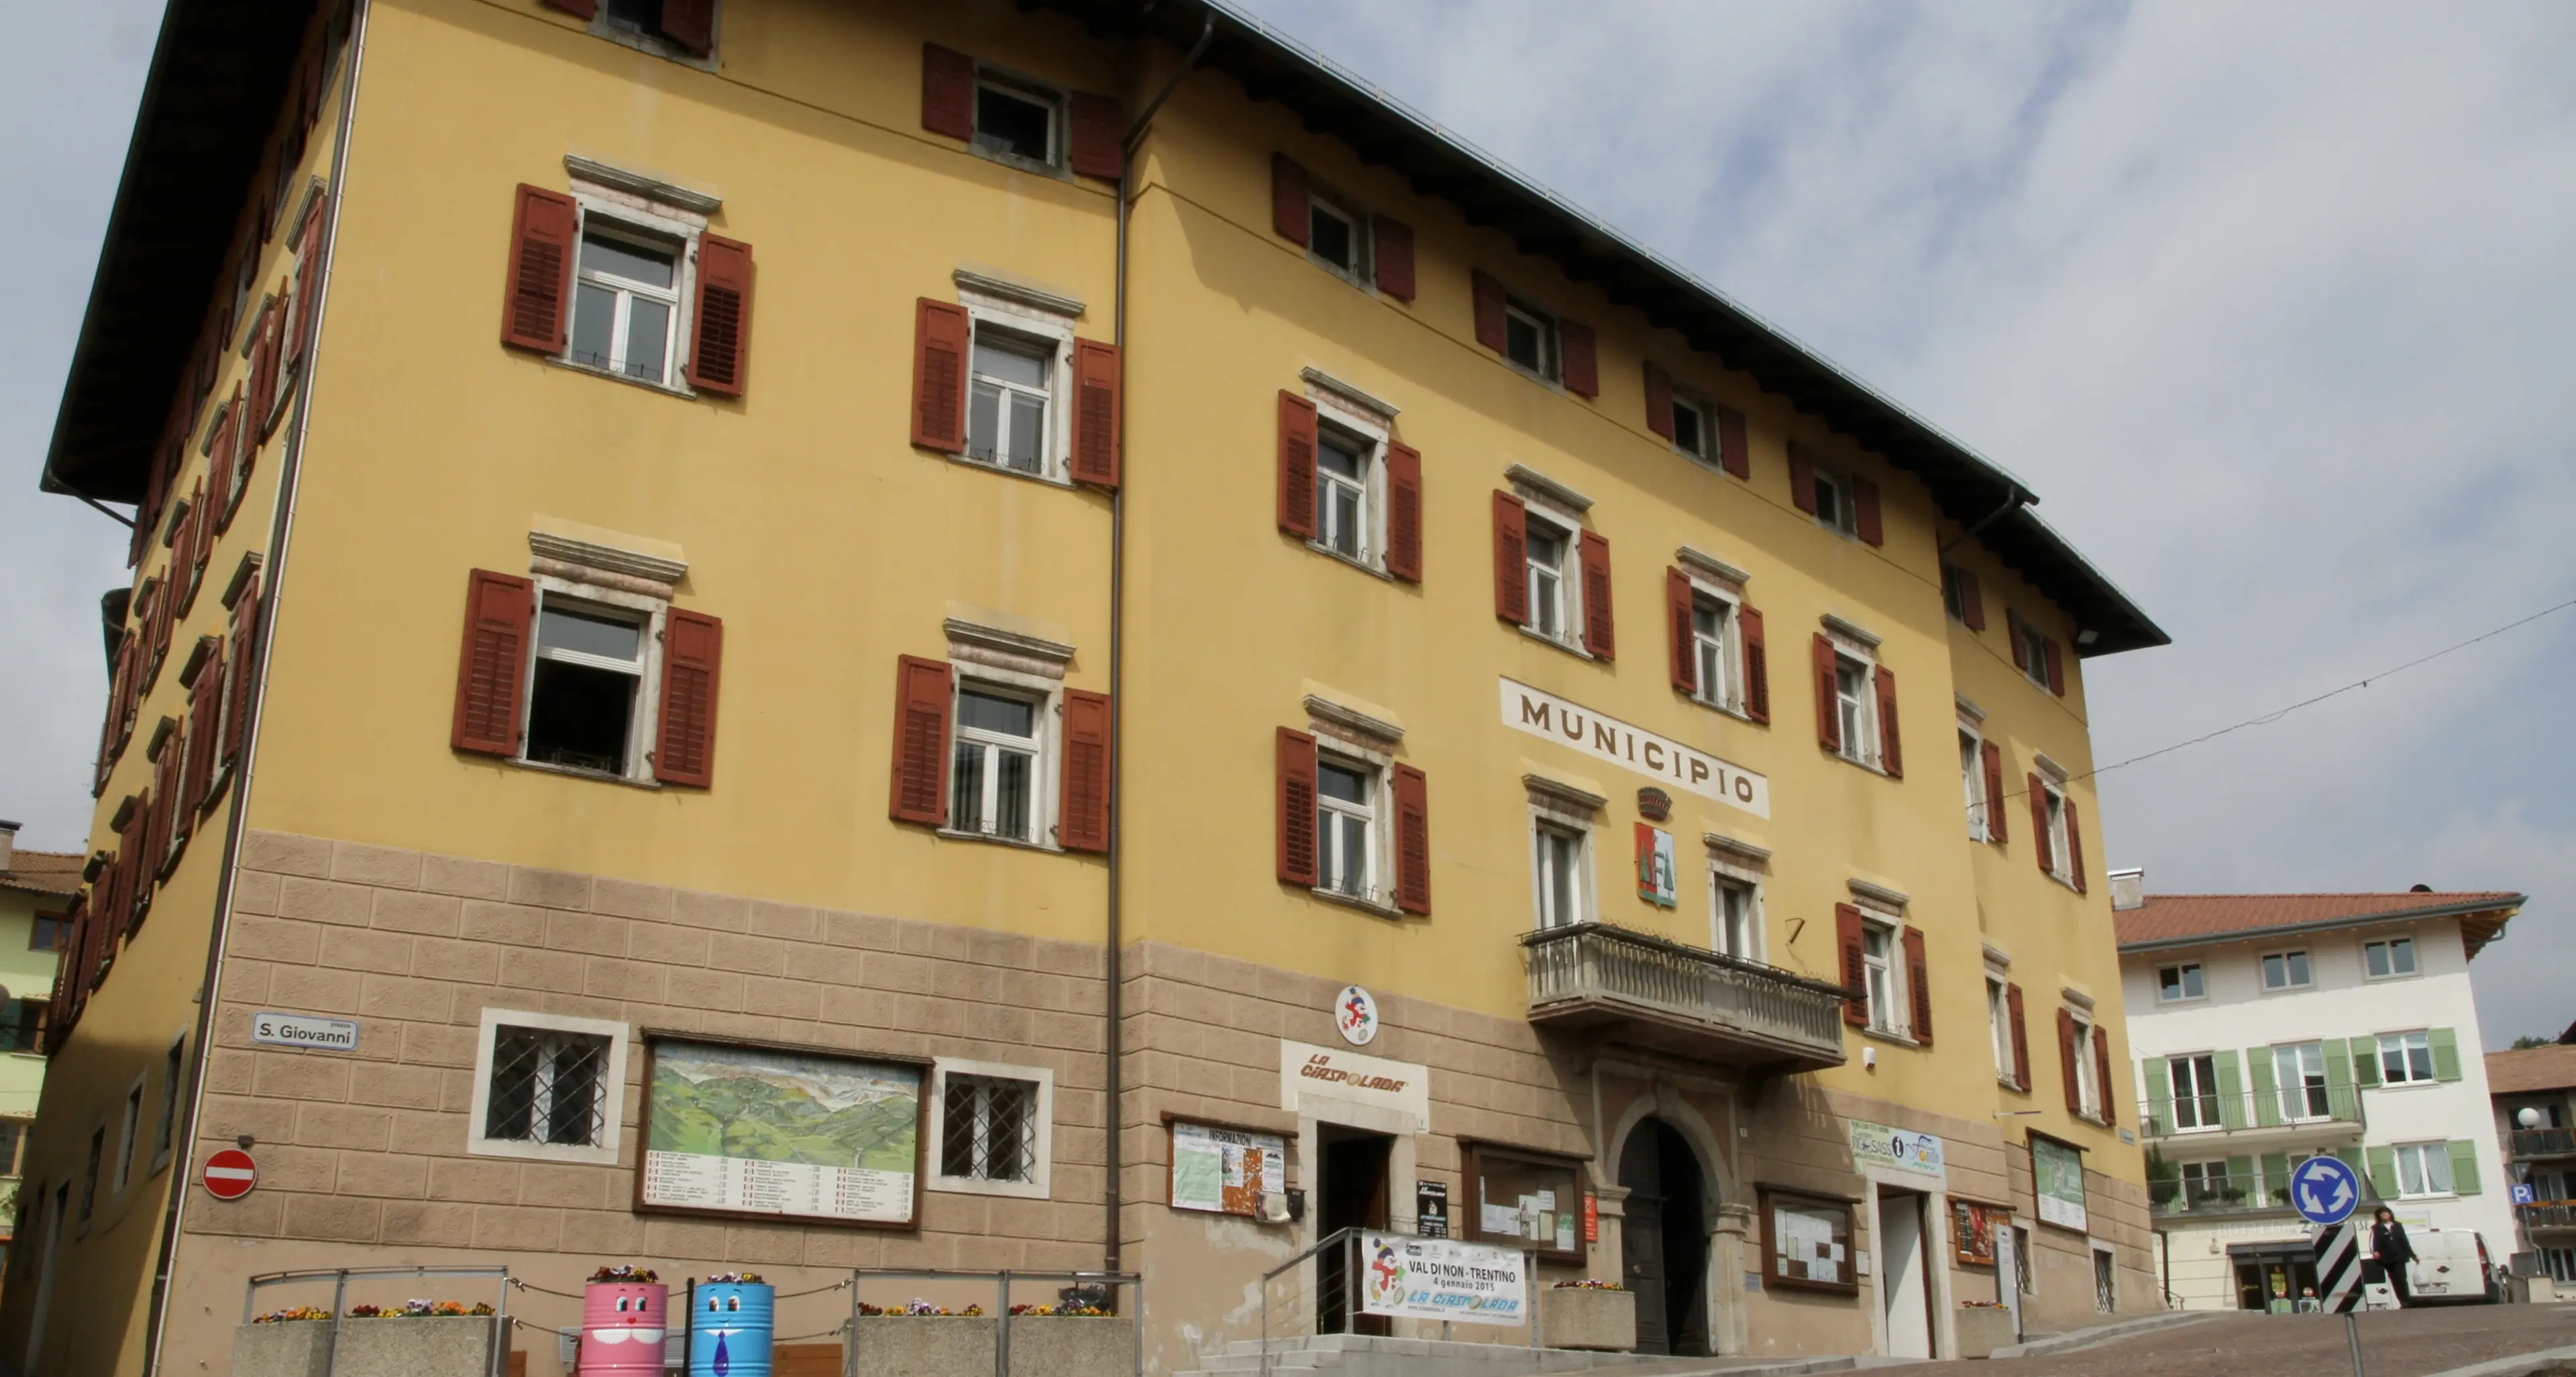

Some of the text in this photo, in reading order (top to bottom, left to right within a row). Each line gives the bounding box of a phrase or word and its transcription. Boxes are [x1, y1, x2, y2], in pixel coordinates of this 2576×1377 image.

[1520, 694, 1754, 803] MUNICIPIO
[260, 1023, 351, 1044] S. Giovanni
[1309, 1054, 1331, 1066] LA
[1409, 1260, 1428, 1274] VAL
[1431, 1263, 1441, 1275] DI
[1444, 1265, 1464, 1278] NON
[1470, 1267, 1515, 1283] TRENTINO
[1433, 1277, 1495, 1291] 4 gennaio 2015
[1408, 1289, 1430, 1303] LA
